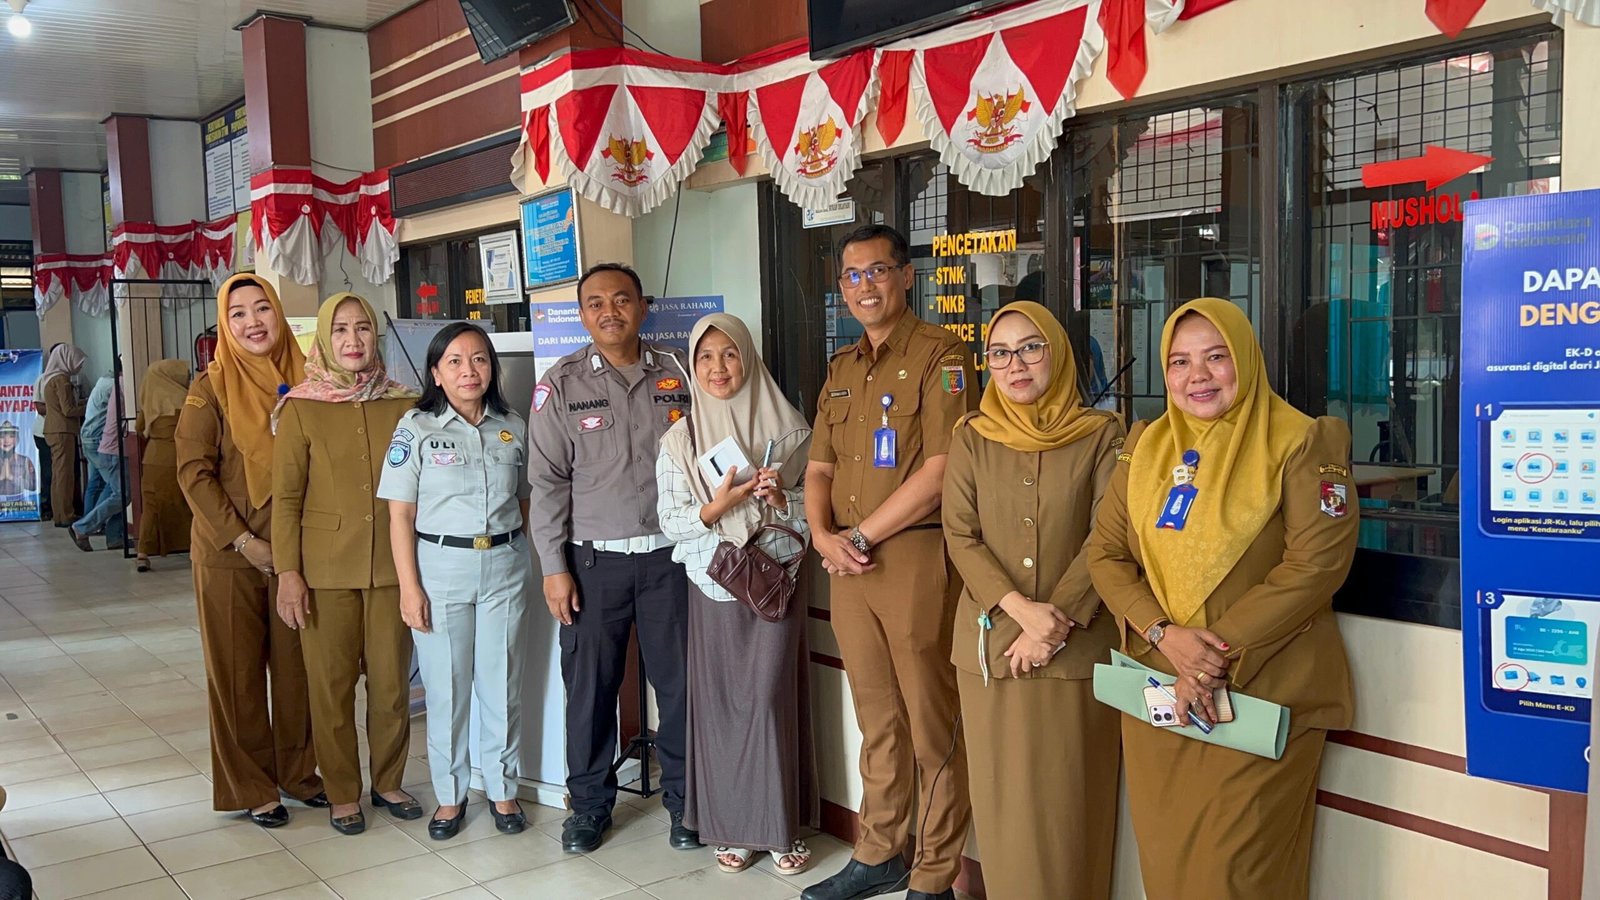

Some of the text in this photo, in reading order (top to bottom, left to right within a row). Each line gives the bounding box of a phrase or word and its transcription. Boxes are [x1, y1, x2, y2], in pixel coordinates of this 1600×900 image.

[1371, 190, 1479, 230] MUSHOL
[932, 229, 1017, 257] PENCETAKAN
[936, 266, 966, 285] STNK
[1523, 267, 1600, 293] DAPA
[680, 301, 717, 310] RAHARJA
[936, 295, 965, 313] TNKB
[1520, 302, 1600, 326] DENG
[538, 337, 558, 345] DARI
[655, 332, 675, 342] JASA
[1565, 348, 1593, 357] EK-D
[1486, 362, 1530, 371] asuransi
[1532, 360, 1566, 373] digital
[1569, 360, 1592, 370] dari
[568, 399, 609, 412] NANANG
[653, 394, 689, 404] POLRI
[1484, 404, 1492, 416] 1
[1492, 516, 1512, 524] Login
[1485, 592, 1496, 605] 3
[1519, 699, 1576, 712] Pilih Menu E-KD
